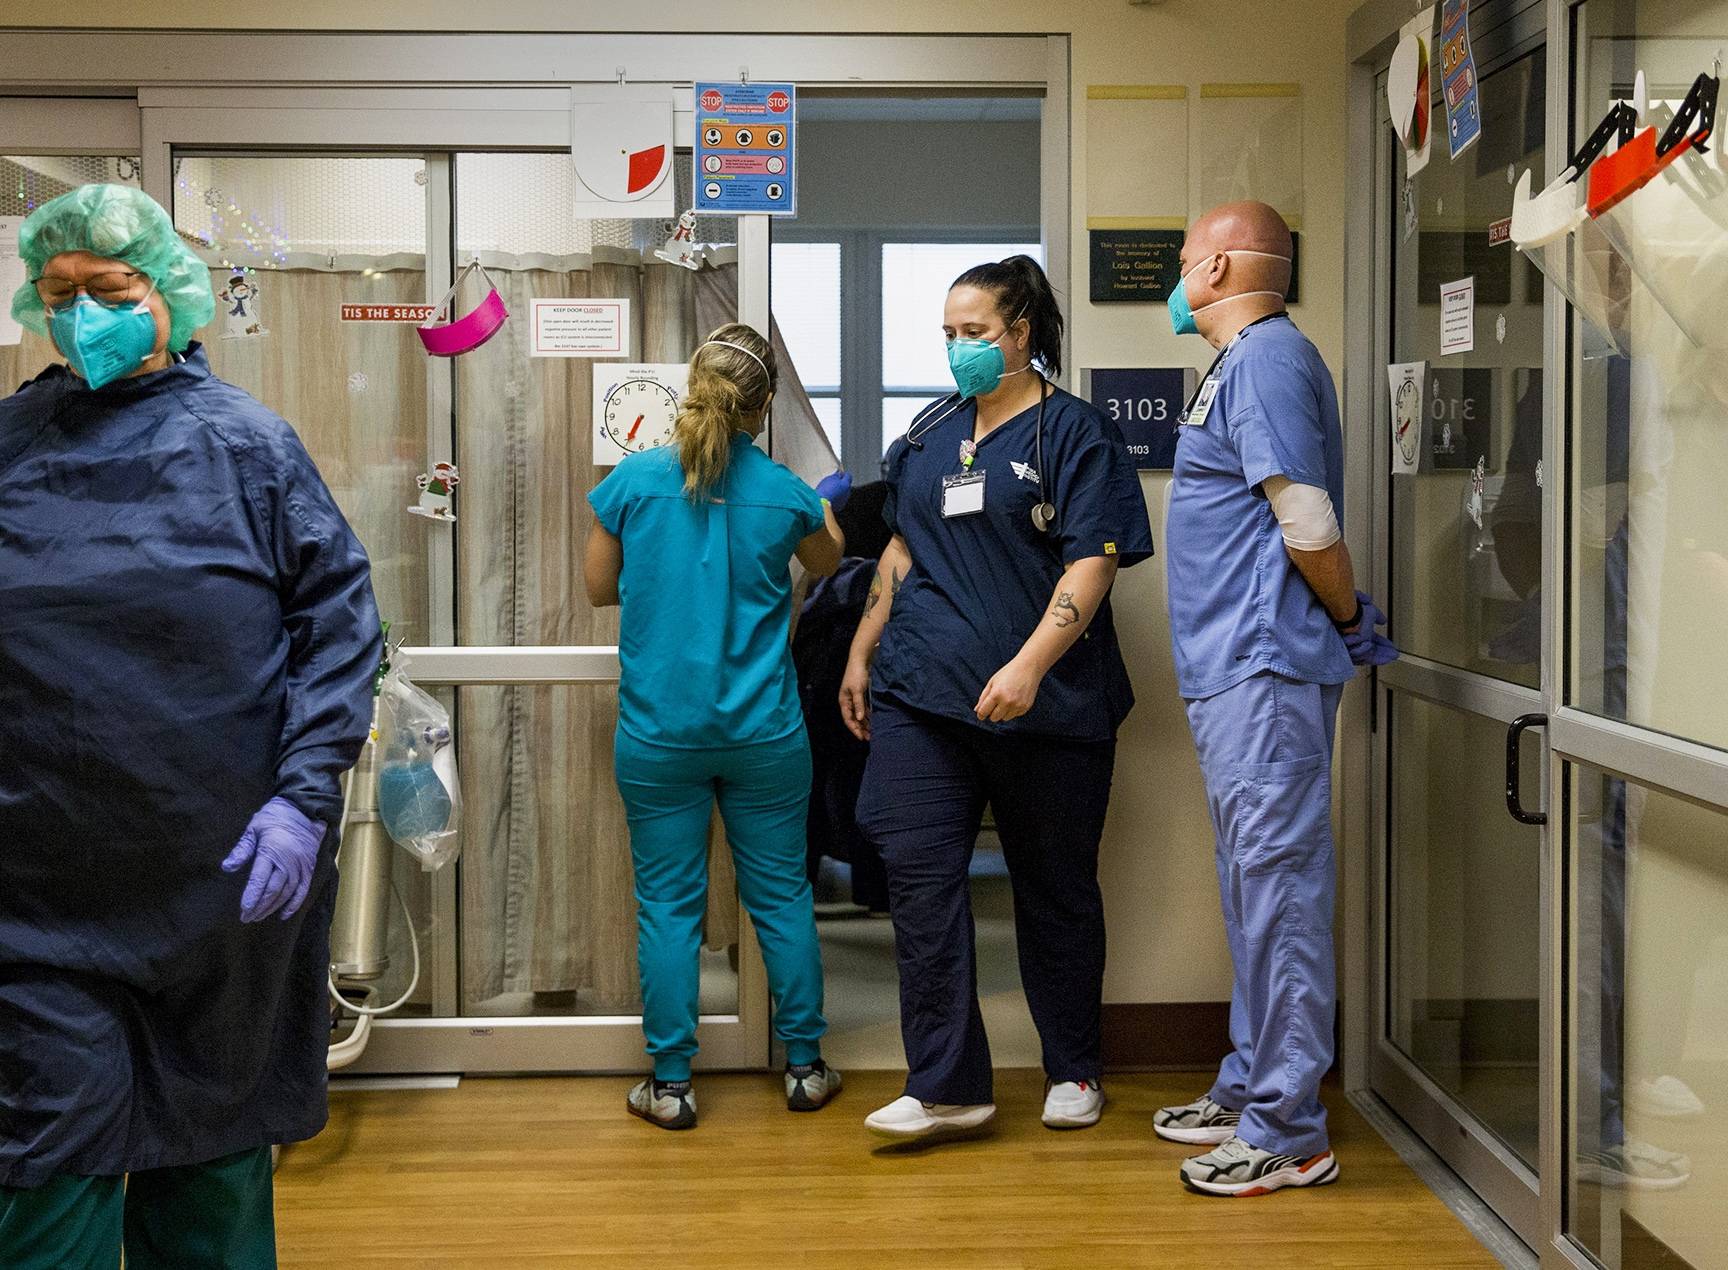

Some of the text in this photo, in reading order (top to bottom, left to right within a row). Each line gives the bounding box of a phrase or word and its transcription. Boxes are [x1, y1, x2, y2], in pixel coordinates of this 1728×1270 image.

[701, 96, 722, 106] STOP
[768, 97, 789, 108] STOP
[1112, 261, 1163, 269] Lois Gallion
[344, 308, 446, 319] TIS THE SEASO
[624, 387, 631, 396] 11
[637, 384, 646, 392] 12
[612, 398, 621, 406] 10
[664, 398, 671, 406] 2
[1107, 398, 1168, 421] 3103
[609, 412, 616, 420] 9
[668, 413, 674, 421] 3
[612, 427, 620, 436] 8
[638, 442, 644, 451] 6
[1127, 445, 1150, 454] 3103
